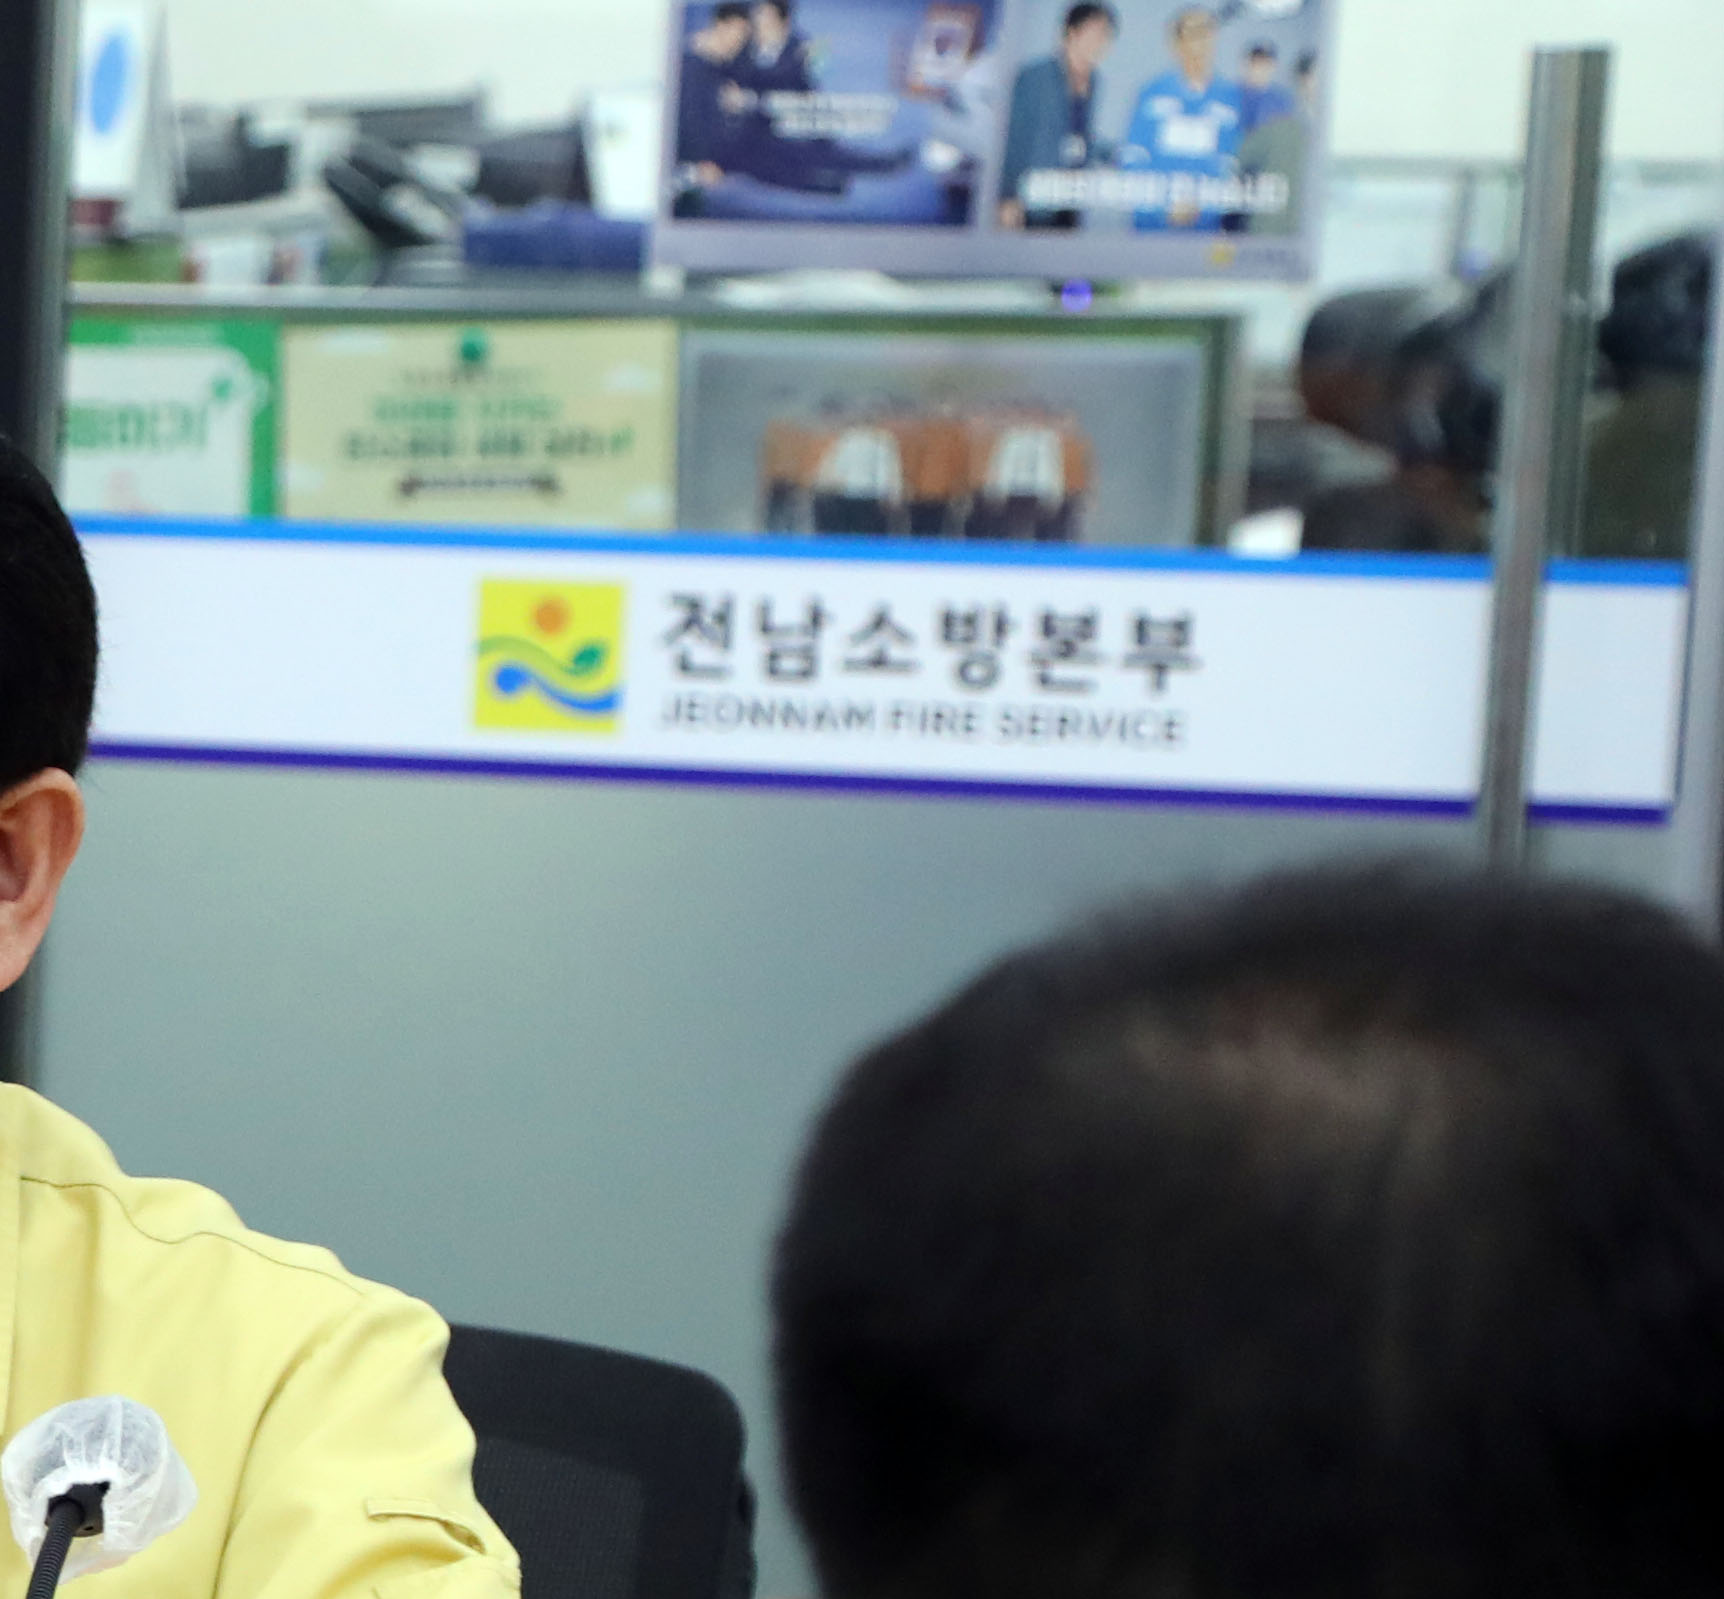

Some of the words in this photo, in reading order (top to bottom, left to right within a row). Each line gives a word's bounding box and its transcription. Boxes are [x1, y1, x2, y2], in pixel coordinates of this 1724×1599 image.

[663, 594, 1199, 693] 전남소방본부
[662, 692, 876, 735] JEONNAM
[890, 703, 980, 738] FIRE
[998, 708, 1184, 748] SERVICE
